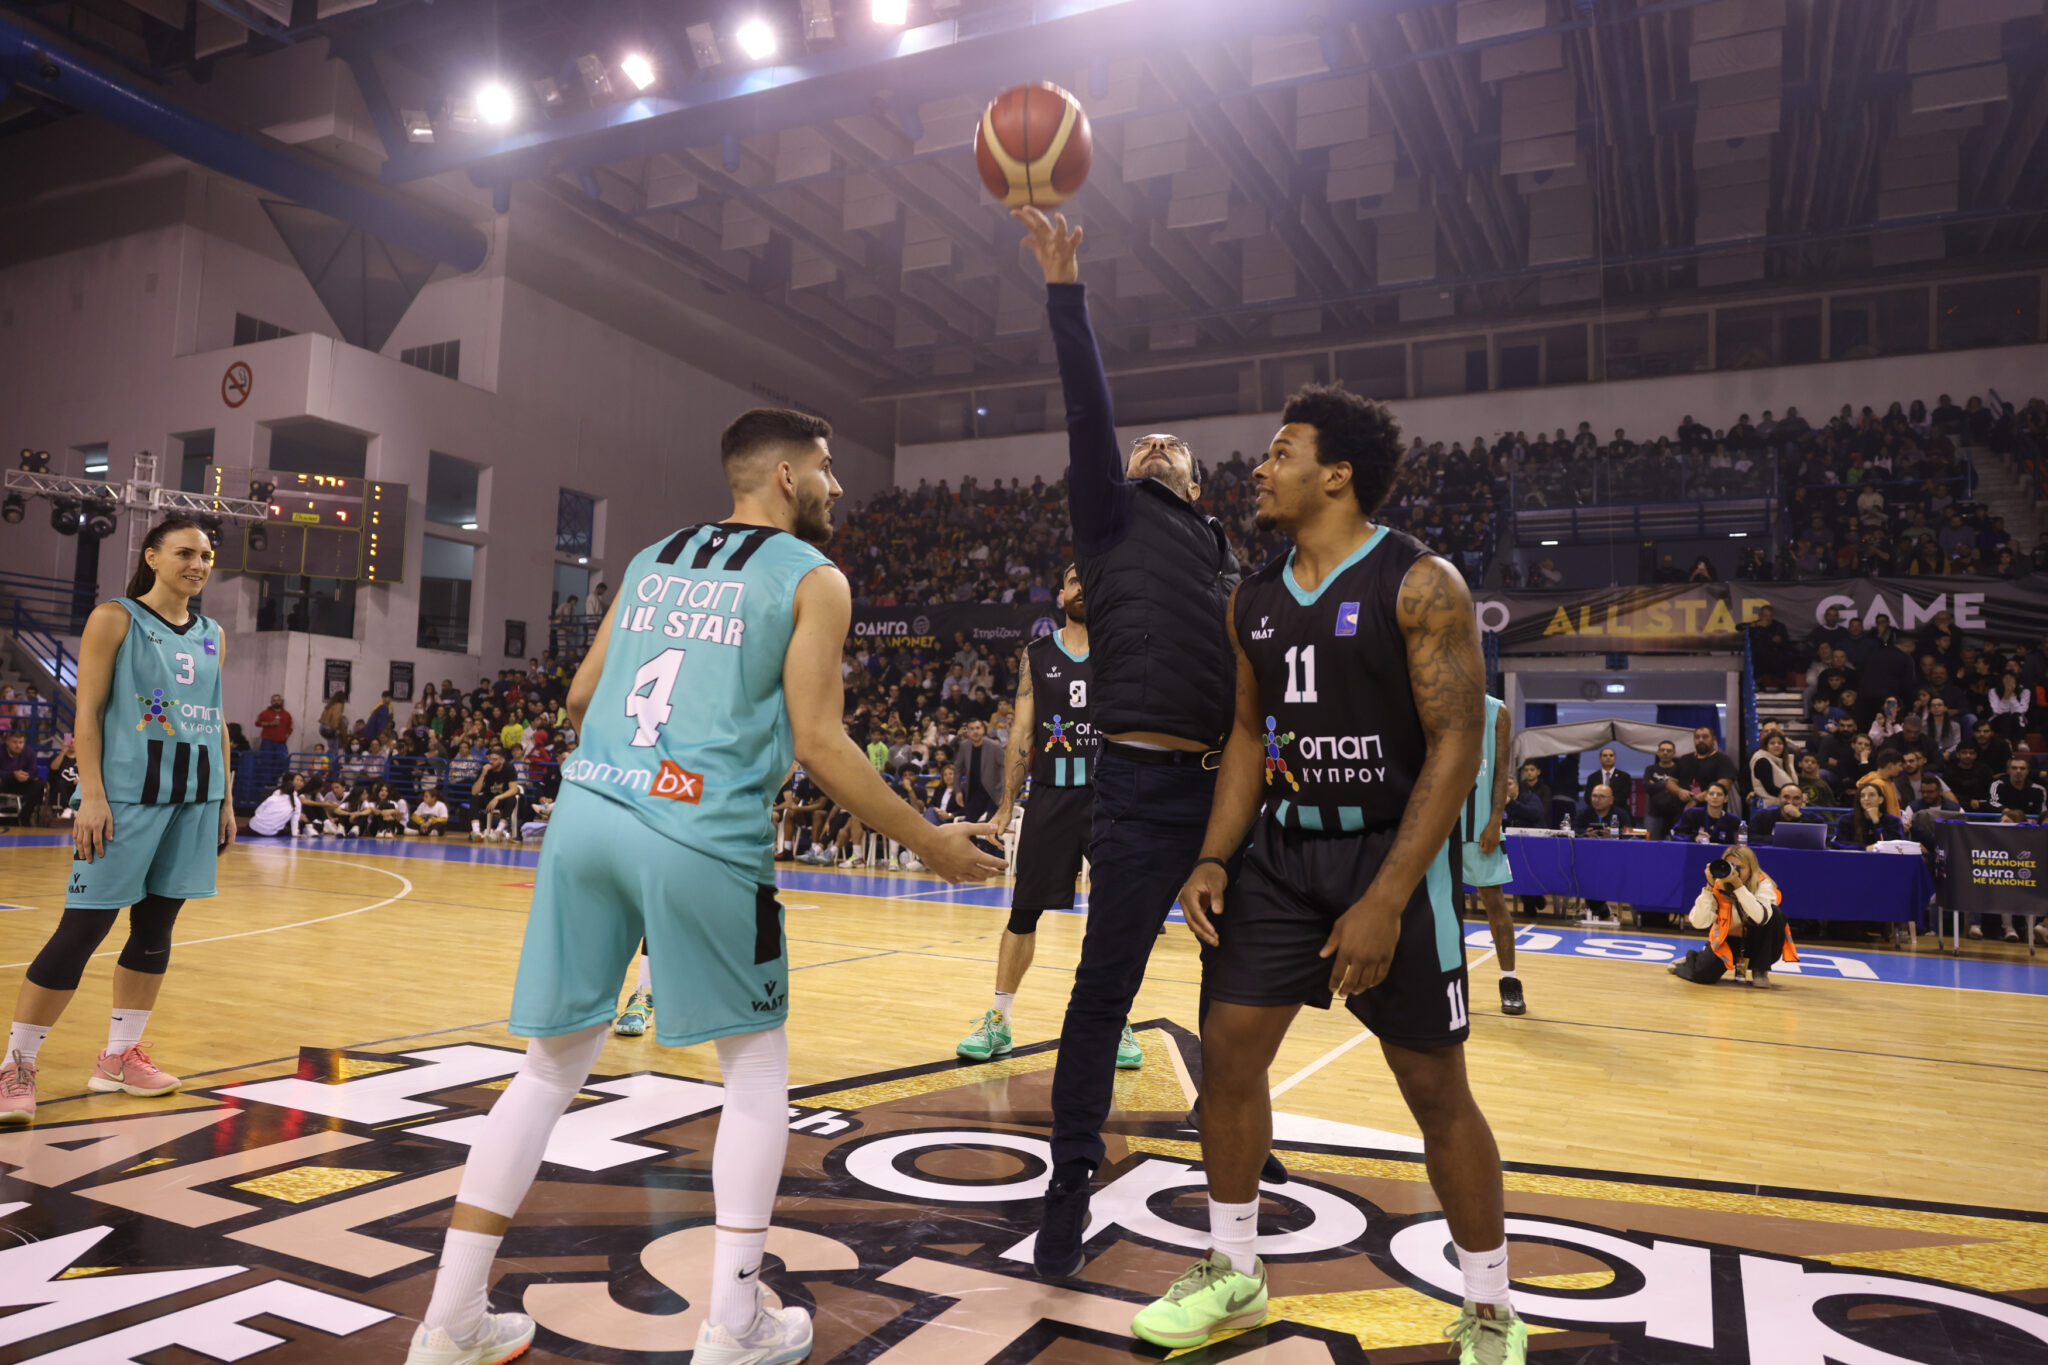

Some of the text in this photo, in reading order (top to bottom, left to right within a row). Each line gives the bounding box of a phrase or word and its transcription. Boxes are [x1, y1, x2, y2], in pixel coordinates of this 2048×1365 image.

[1542, 604, 1633, 635] ALL
[1815, 592, 1986, 631] GAME
[663, 610, 746, 647] STAR
[854, 621, 908, 636] ΟΔΗΓΩ
[174, 651, 196, 686] 3
[1284, 644, 1318, 703] 11
[624, 647, 687, 748] 4
[1302, 767, 1386, 783] ΚΥΠΡΟΥ
[1971, 849, 2009, 859] ΠΑΙΖΩ
[1988, 859, 2037, 868] ΚΑΝΟΝΕΣ
[1972, 868, 2015, 878] ΟΔΗΓΩ
[1988, 878, 2038, 887] ΚΑΝΟΝΕΣ
[751, 993, 786, 1012] VAAT
[1446, 978, 1468, 1032] 11
